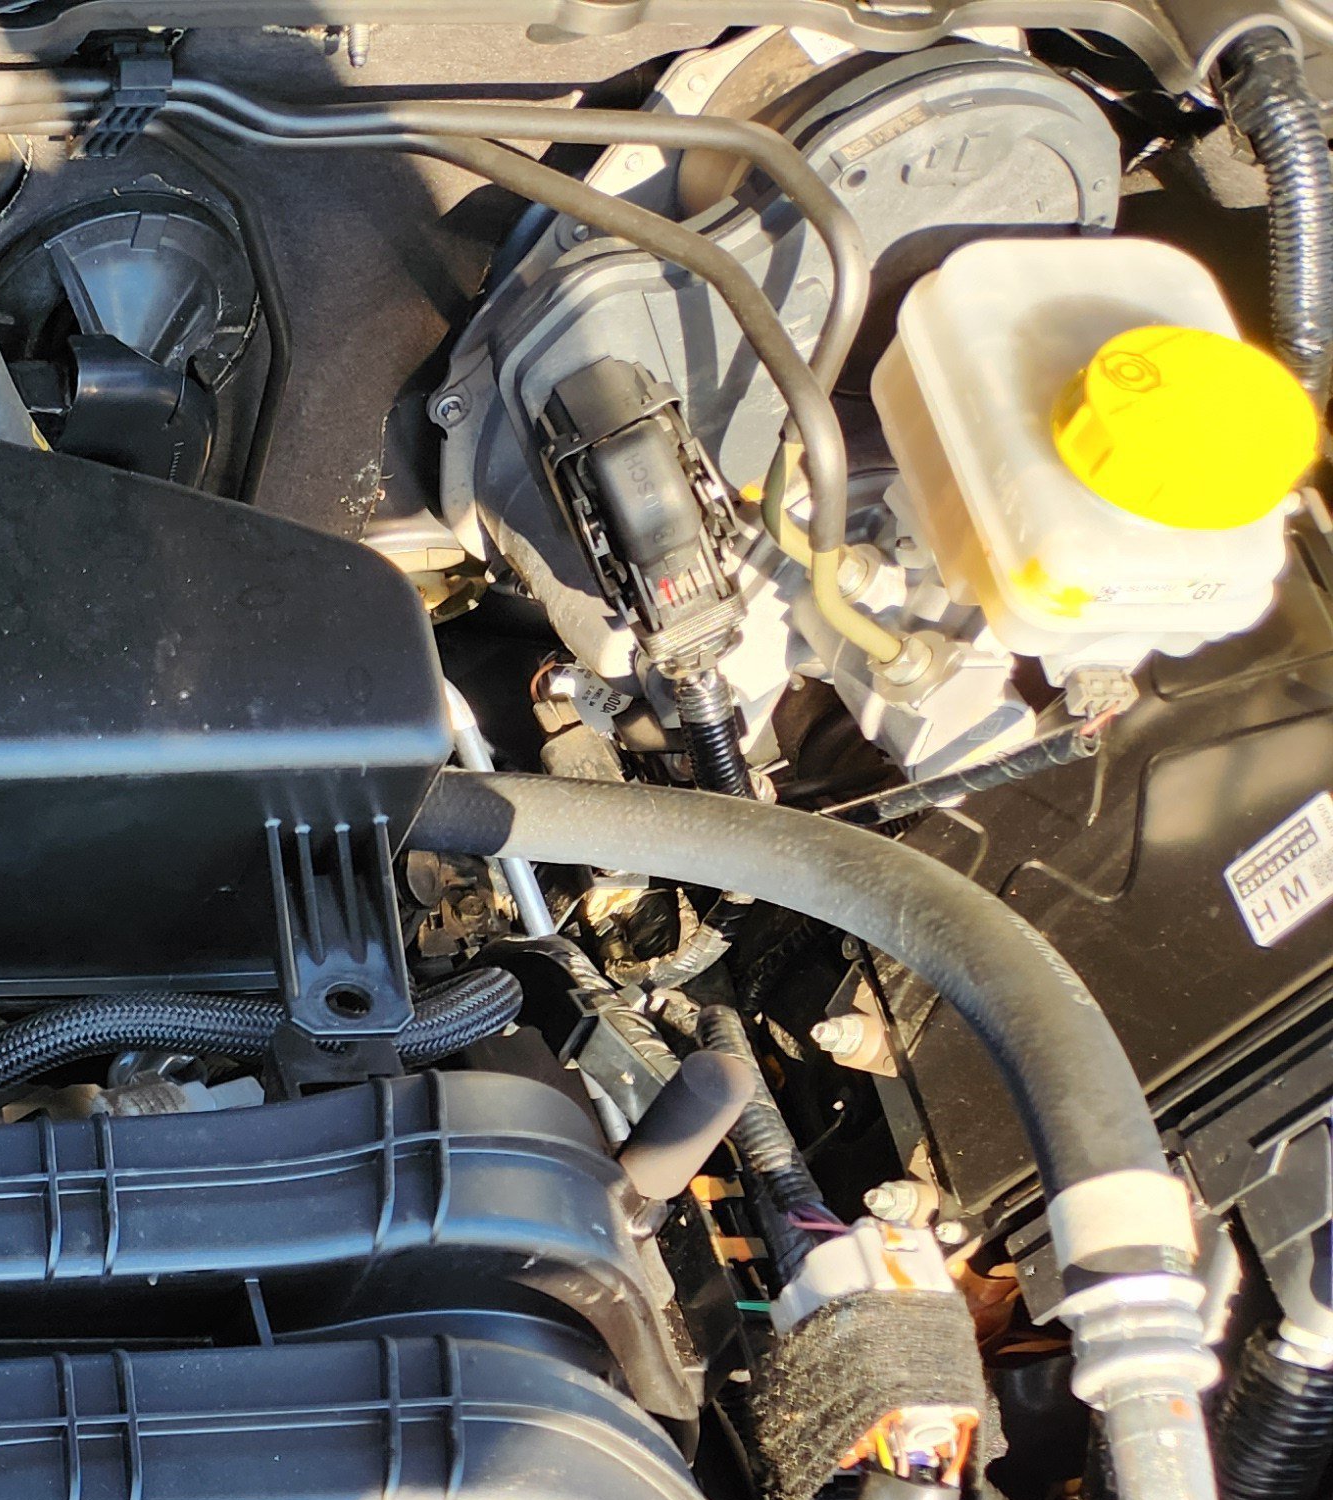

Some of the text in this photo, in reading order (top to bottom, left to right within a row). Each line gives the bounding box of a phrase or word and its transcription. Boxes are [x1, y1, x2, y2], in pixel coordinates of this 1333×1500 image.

[1193, 583, 1226, 600] GT
[1251, 875, 1310, 932] H M
